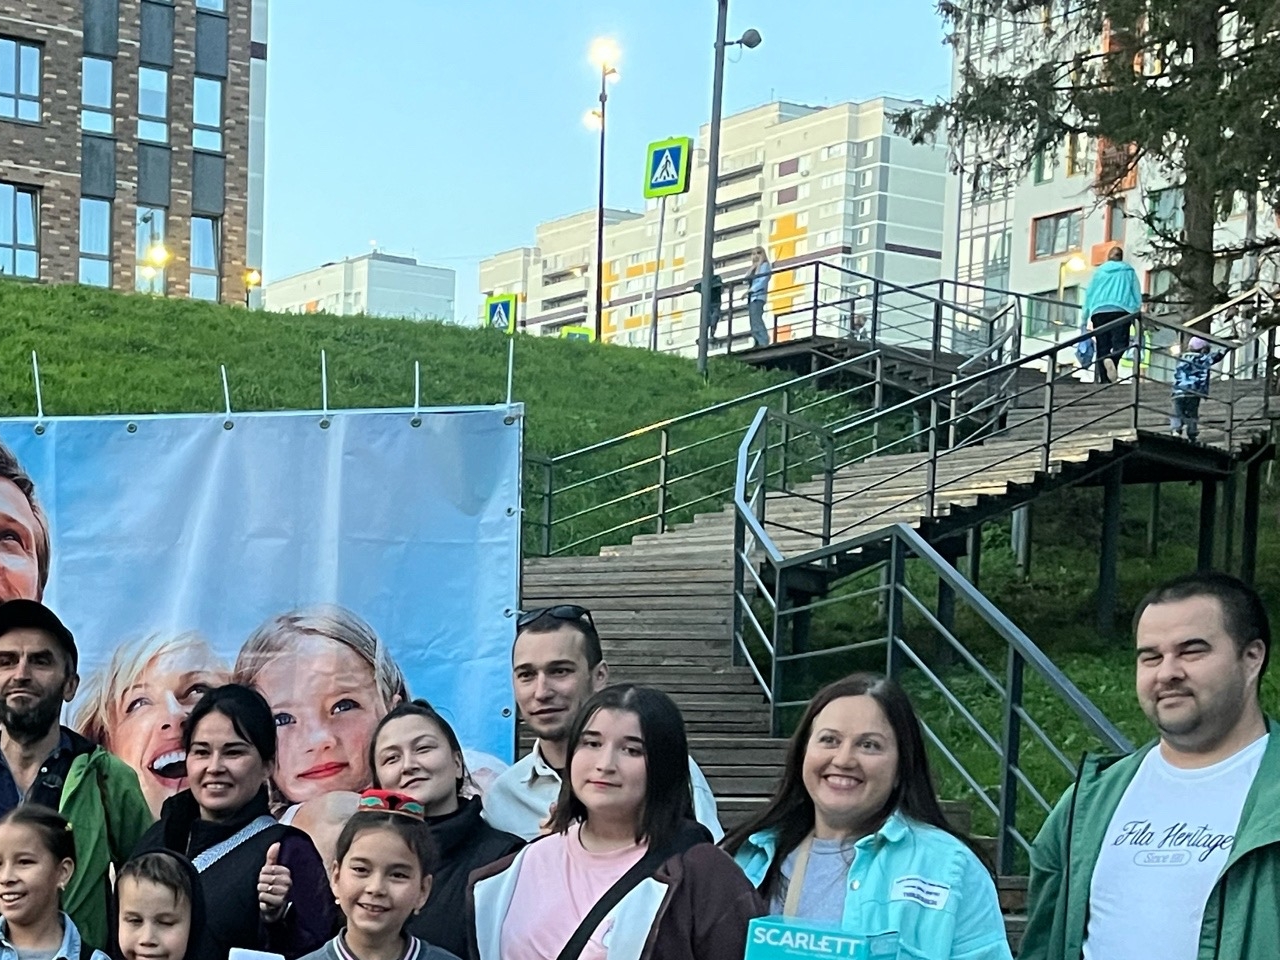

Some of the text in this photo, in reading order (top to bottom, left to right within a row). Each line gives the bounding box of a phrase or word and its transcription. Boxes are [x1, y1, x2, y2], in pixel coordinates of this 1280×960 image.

[1111, 819, 1235, 863] Fila Heritage
[1144, 852, 1169, 864] Since
[753, 926, 862, 956] SCARLETT
